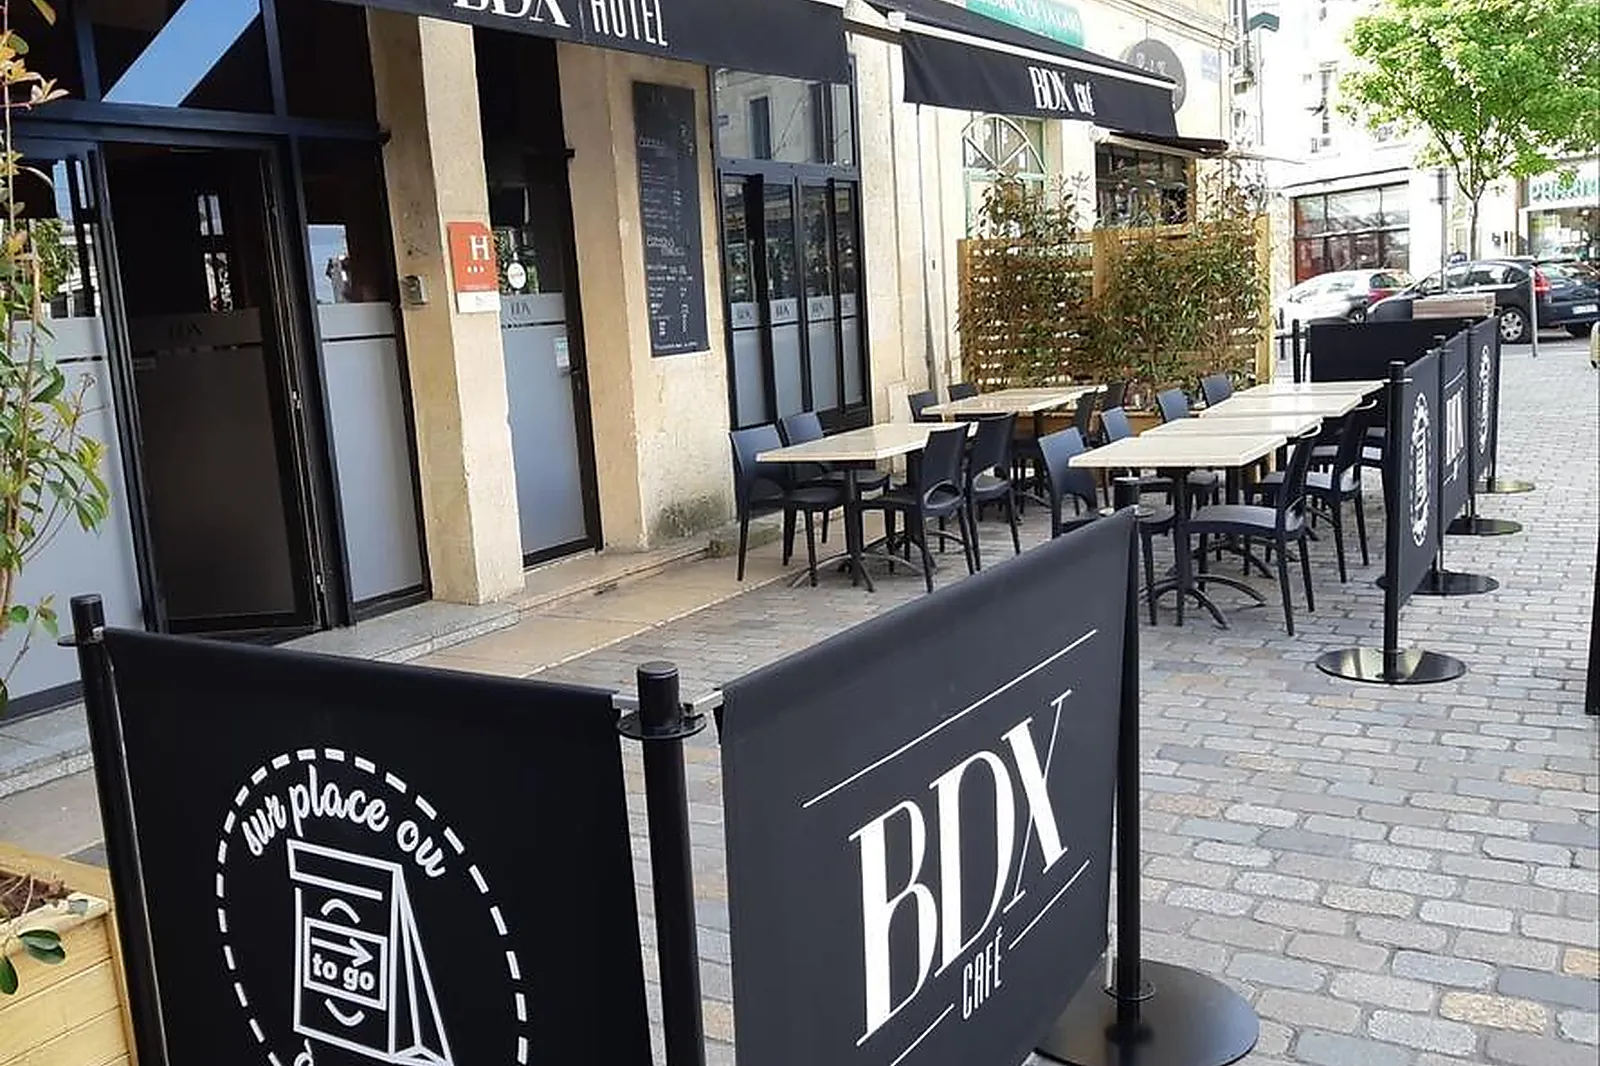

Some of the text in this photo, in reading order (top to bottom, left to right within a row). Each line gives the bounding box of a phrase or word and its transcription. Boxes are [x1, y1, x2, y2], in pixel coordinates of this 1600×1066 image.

[1028, 66, 1075, 112] BDX
[470, 234, 491, 261] H
[241, 764, 447, 878] sur place ou
[847, 689, 1072, 1047] BDX
[311, 952, 375, 992] to go
[962, 926, 1003, 1021] CAFÉ
